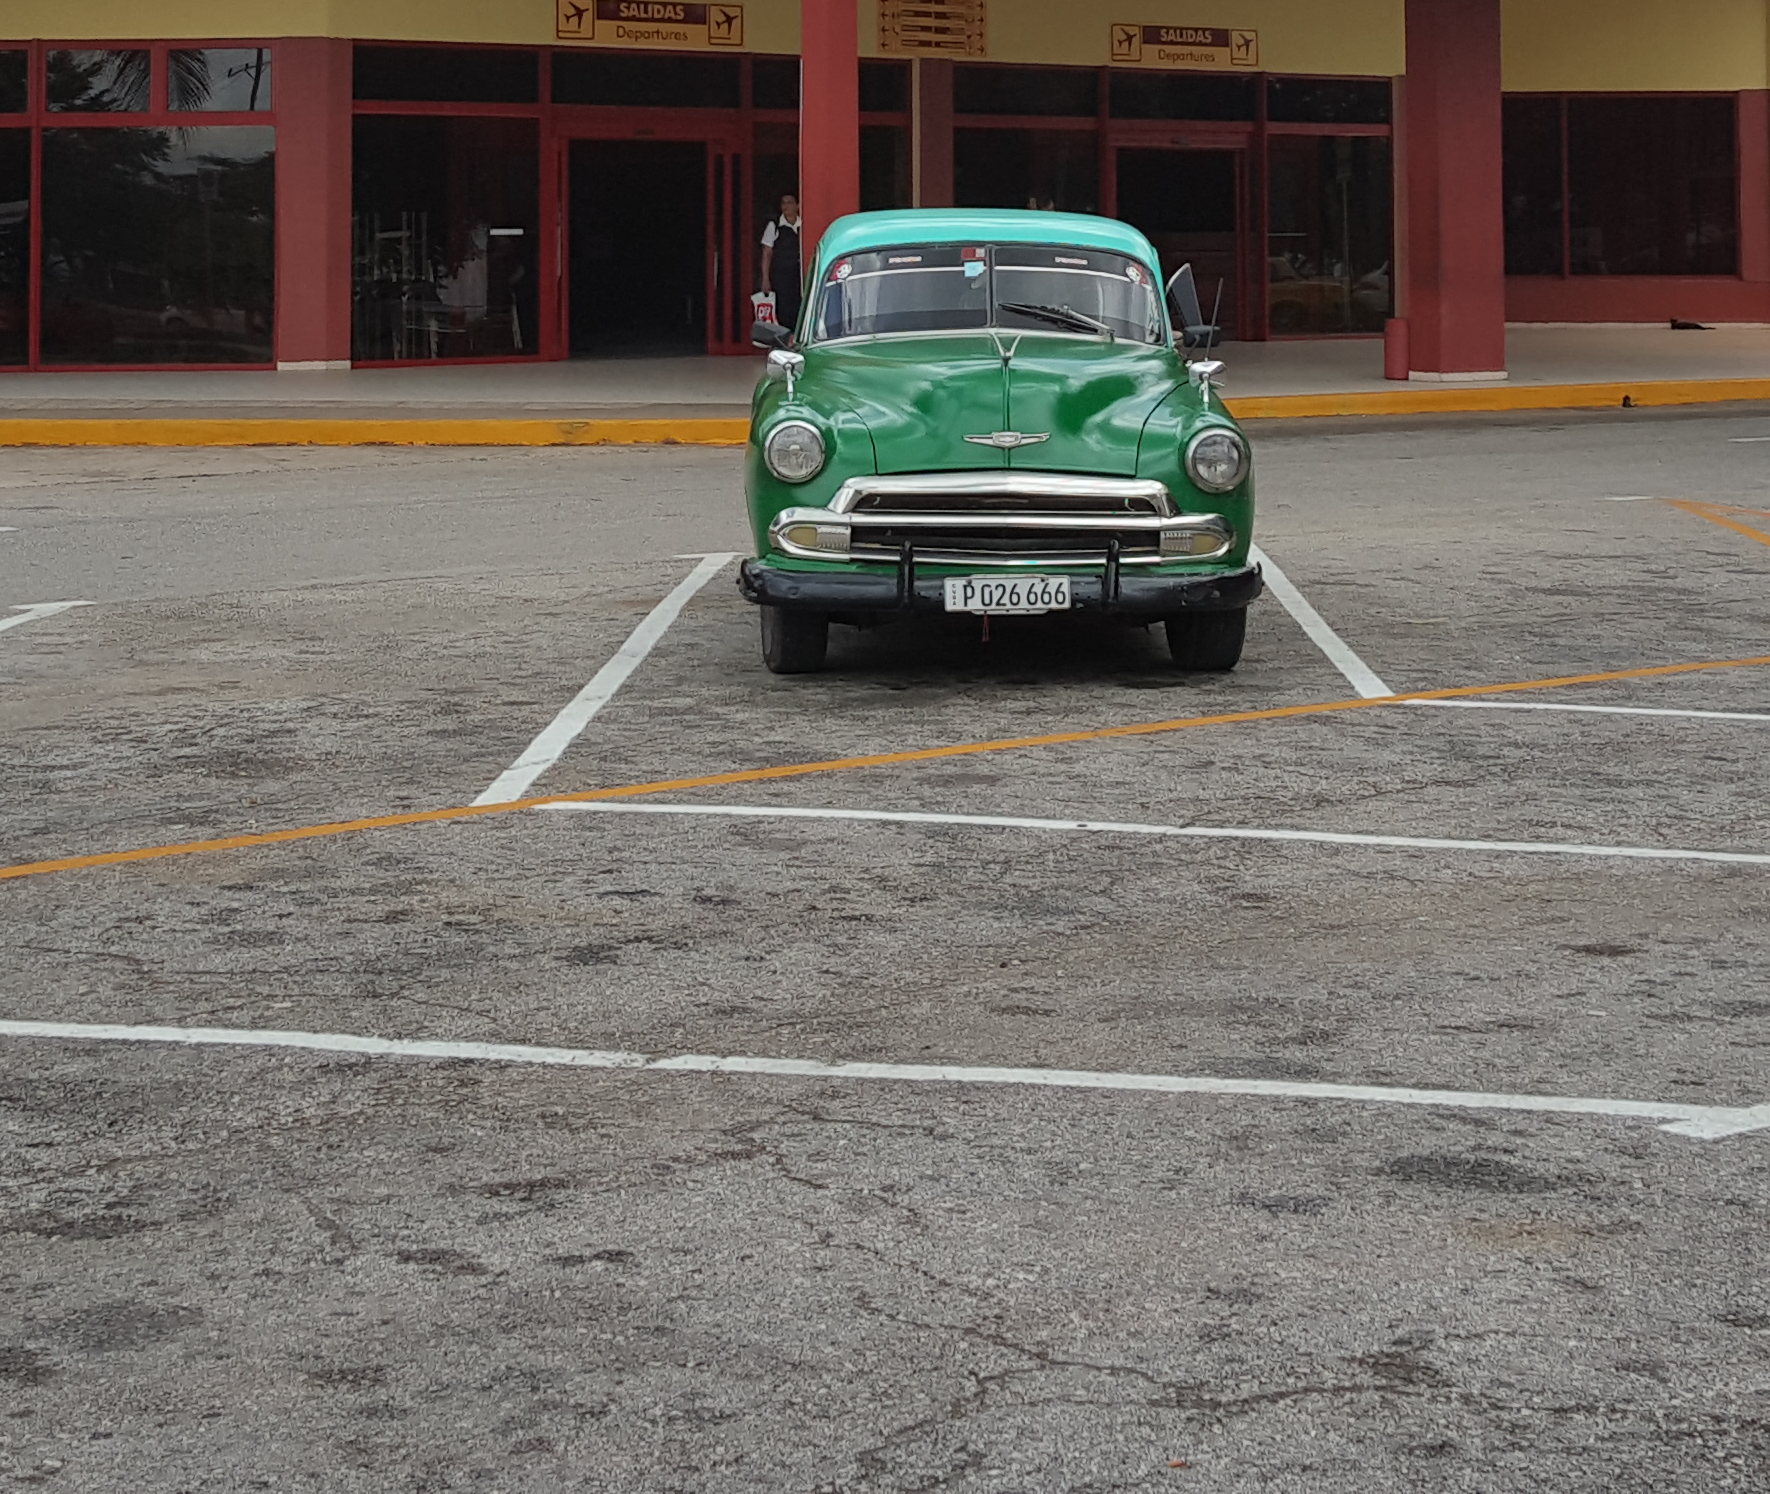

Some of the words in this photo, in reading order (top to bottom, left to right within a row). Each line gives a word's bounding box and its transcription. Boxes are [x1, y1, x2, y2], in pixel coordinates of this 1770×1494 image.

[619, 2, 685, 20] SALIDAS
[616, 25, 689, 42] Departures
[1160, 28, 1212, 43] SALIDAS
[1157, 48, 1215, 64] Departures
[1026, 582, 1066, 606] 666
